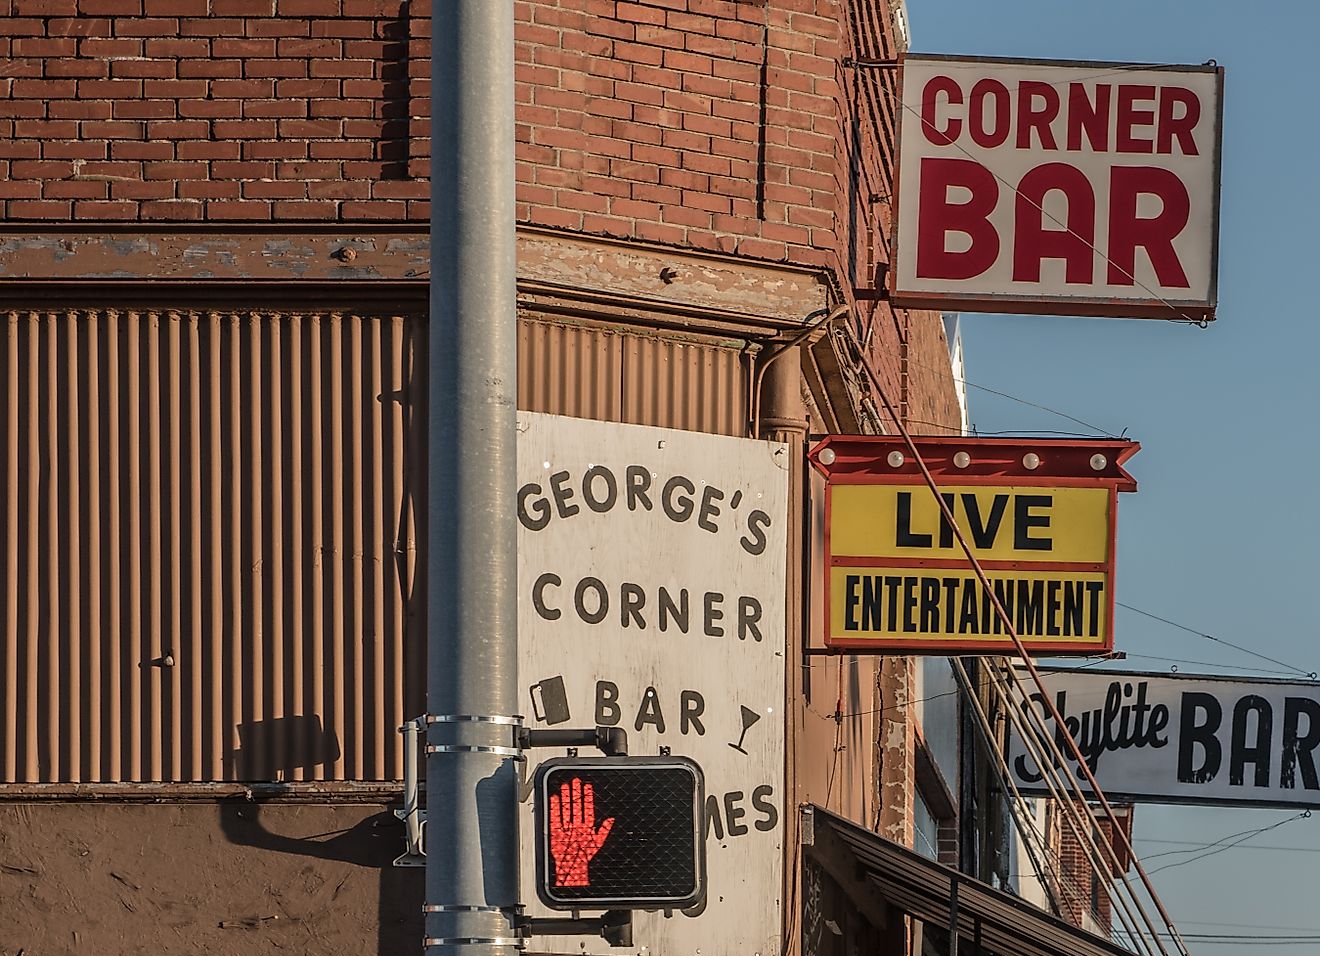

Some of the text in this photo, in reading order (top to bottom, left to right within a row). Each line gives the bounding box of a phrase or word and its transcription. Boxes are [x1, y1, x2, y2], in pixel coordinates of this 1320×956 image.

[921, 75, 1201, 156] CORNER
[917, 157, 1192, 288] BAR
[517, 465, 771, 556] GEORGE'S
[896, 491, 1054, 551] LIVE
[532, 572, 762, 642] CORNER
[844, 574, 1105, 639] ENTERTAINMENT
[594, 680, 706, 736] BAR
[1014, 681, 1169, 783] Skylite
[705, 785, 778, 840] MES
